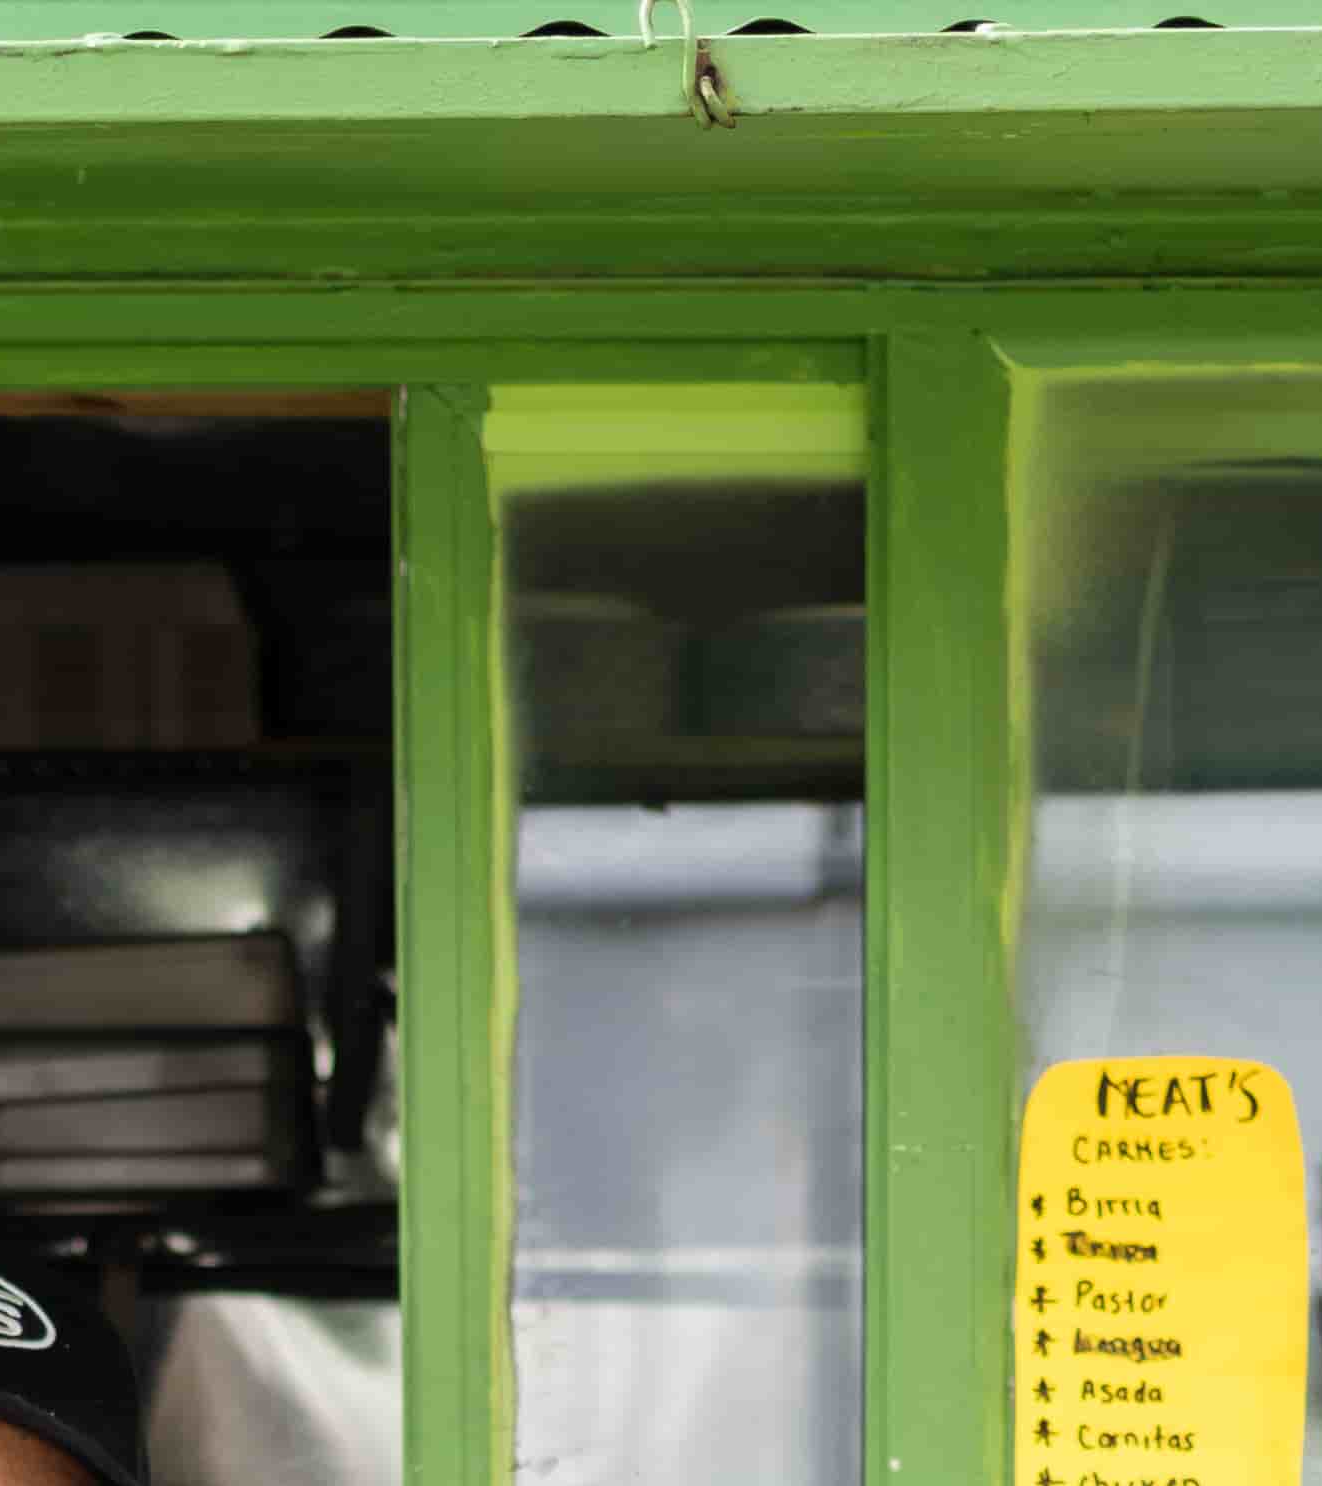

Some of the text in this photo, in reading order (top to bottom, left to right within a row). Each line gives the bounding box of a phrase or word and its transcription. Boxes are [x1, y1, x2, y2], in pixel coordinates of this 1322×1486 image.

[1095, 1067, 1262, 1122] MEAT'S
[1075, 1279, 1168, 1315] Pastor
[1080, 1380, 1164, 1405] Asada
